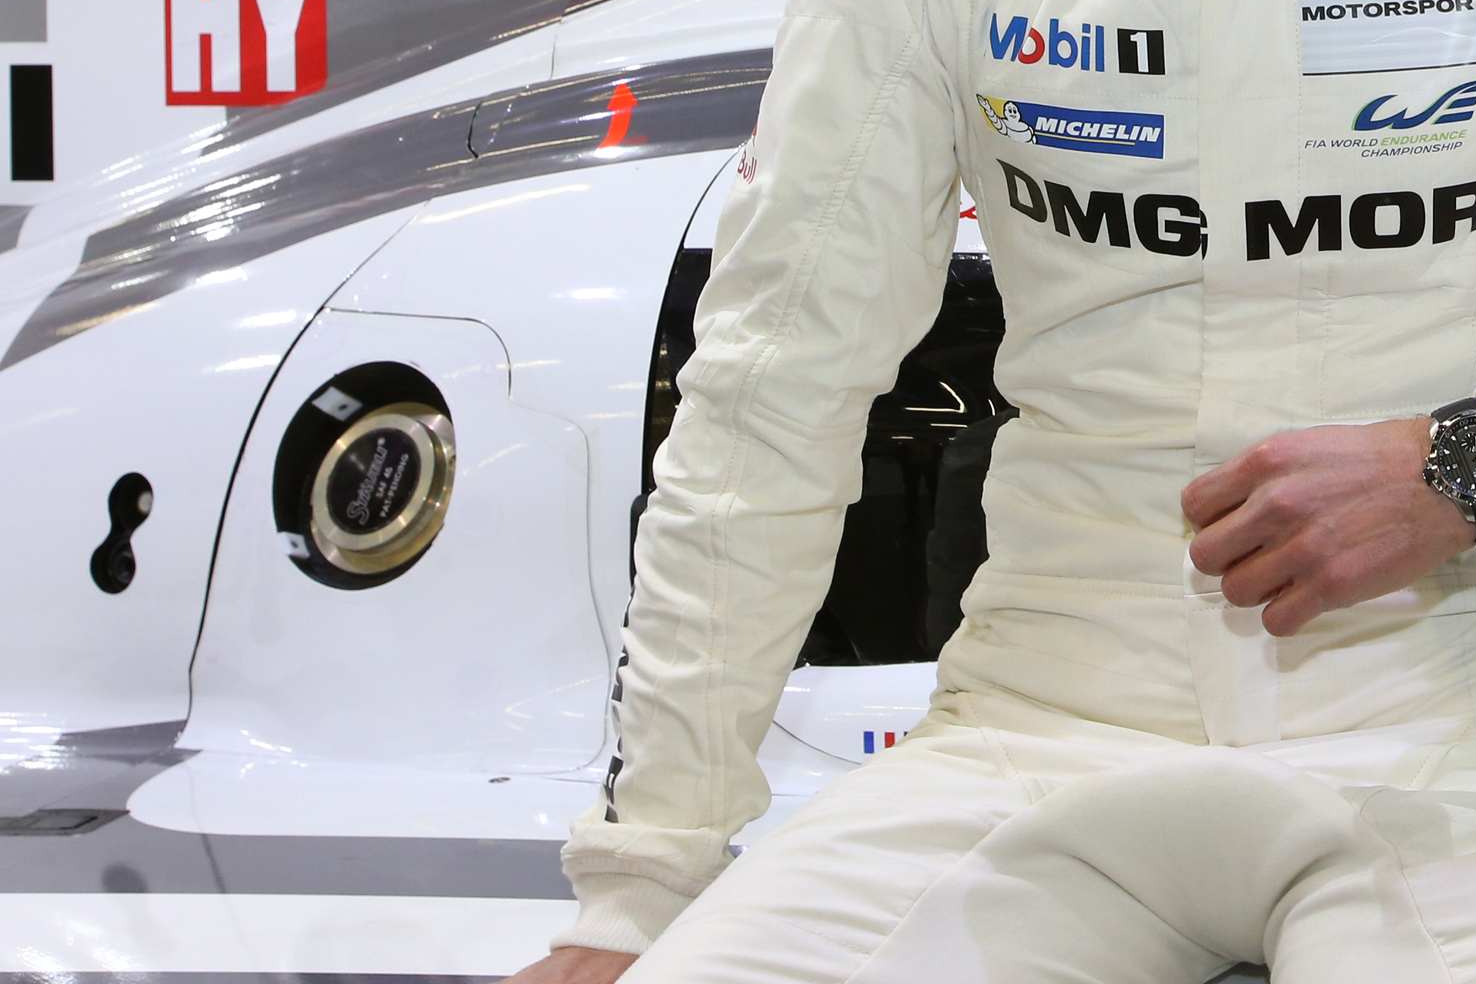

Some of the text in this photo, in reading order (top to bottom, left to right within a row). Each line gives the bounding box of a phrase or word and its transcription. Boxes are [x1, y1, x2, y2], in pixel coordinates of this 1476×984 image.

[989, 12, 1106, 72] Mobil
[1033, 115, 1162, 143] MICHELIN
[1304, 129, 1468, 149] FIA WORLD ENDURANCE
[1360, 141, 1463, 158] CHAMPIONSHIP
[995, 158, 1209, 261] DMG
